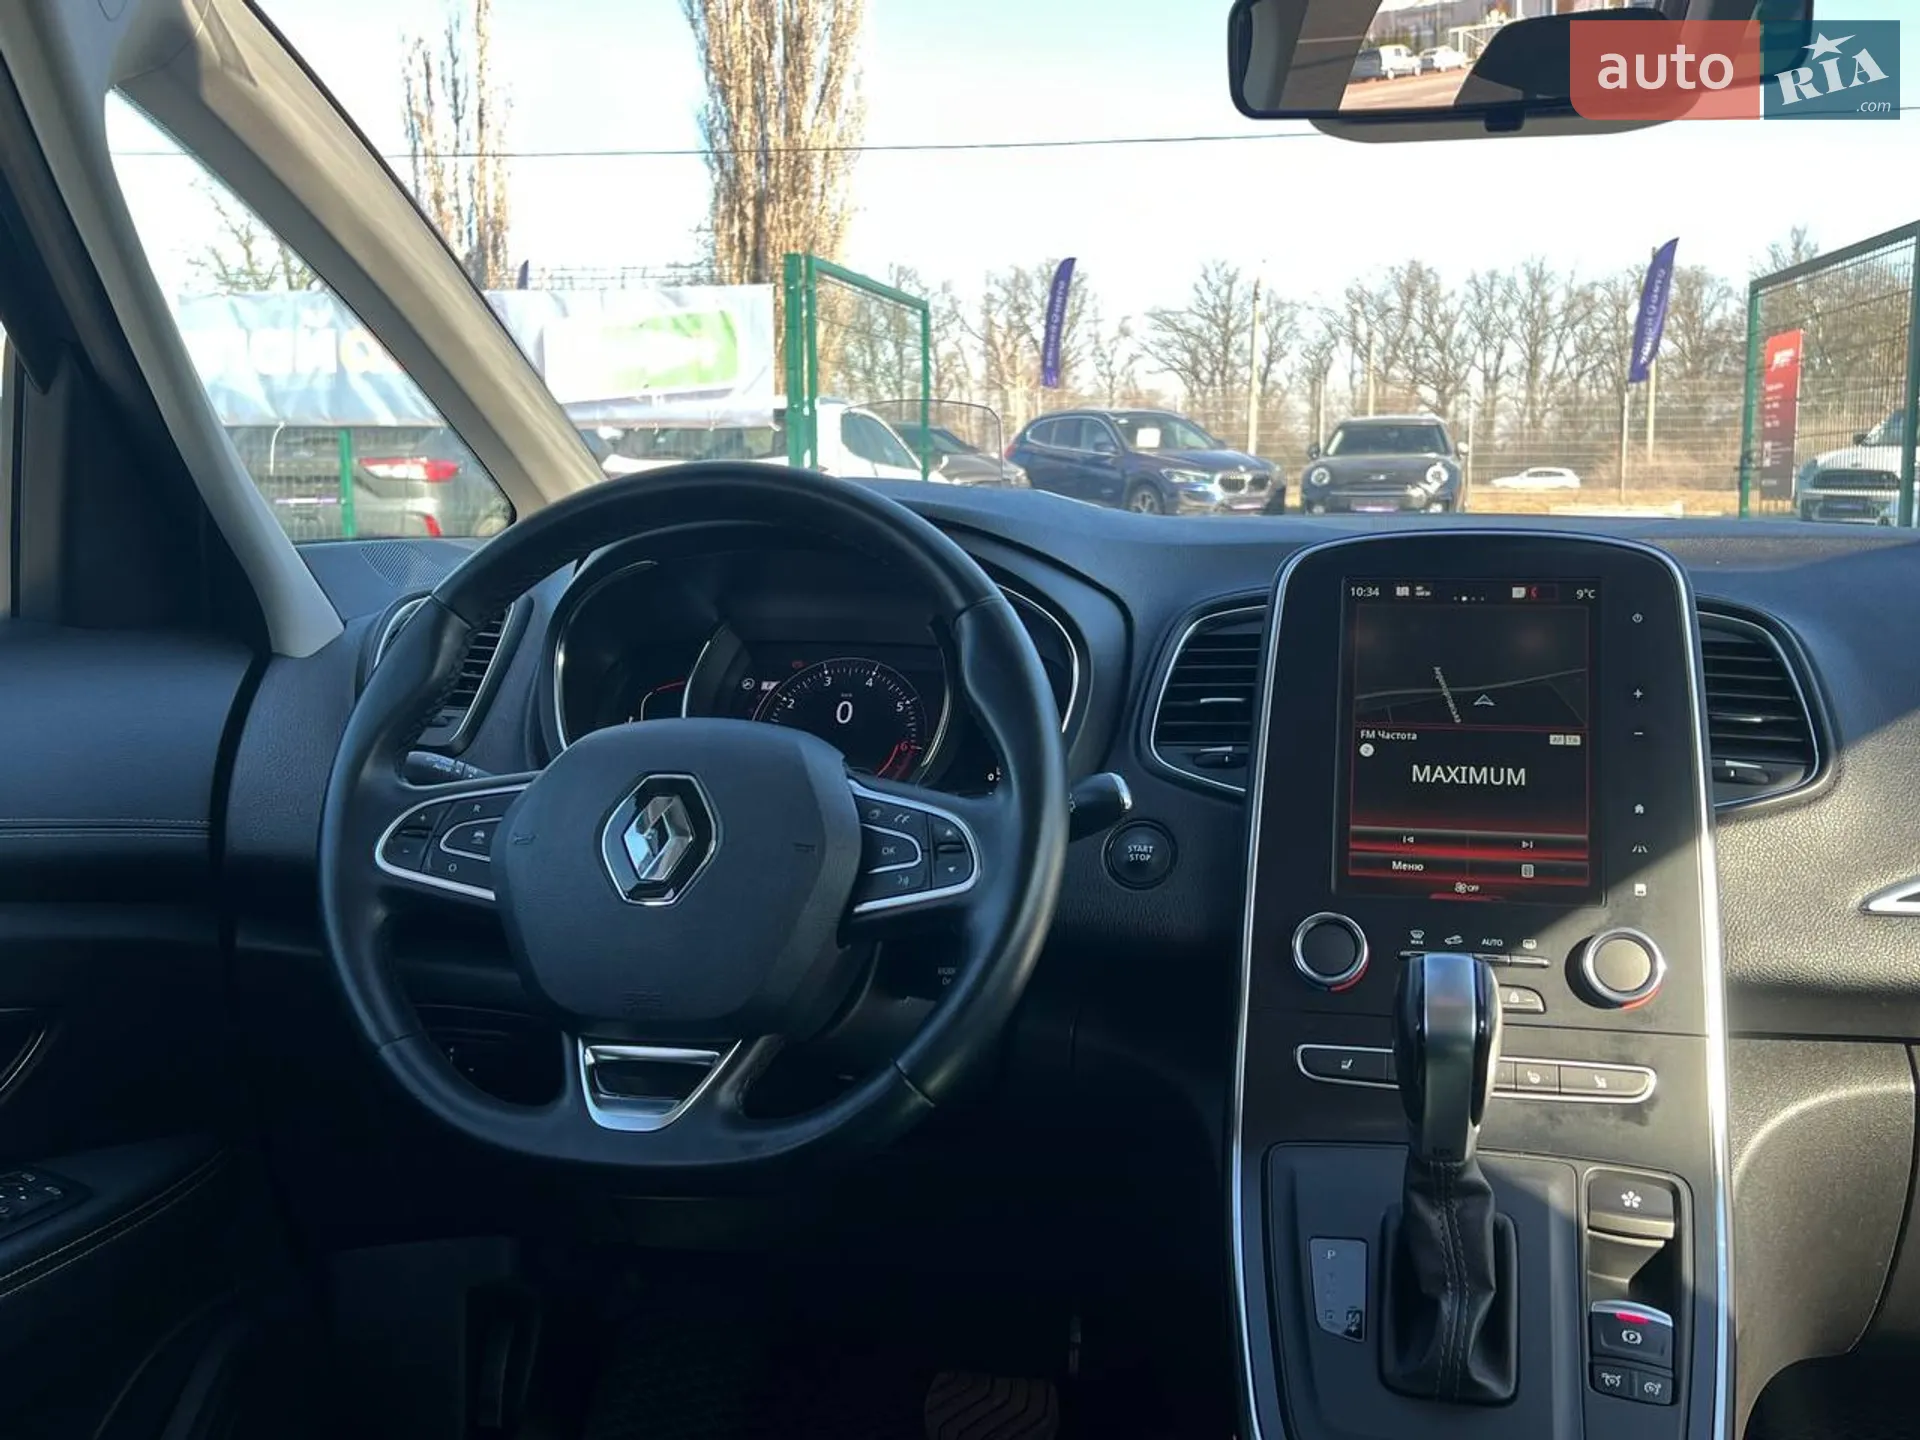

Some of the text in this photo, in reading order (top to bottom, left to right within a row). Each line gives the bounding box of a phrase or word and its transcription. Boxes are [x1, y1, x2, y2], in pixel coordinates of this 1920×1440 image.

[1350, 586, 1380, 598] 10:34
[1576, 588, 1596, 599] 9°C
[823, 676, 832, 687] 3
[865, 677, 874, 687] 4
[787, 699, 796, 710] 2
[896, 701, 904, 712] 5
[836, 701, 853, 724] 0
[1360, 729, 1417, 741] FM Частота
[900, 740, 909, 751] 6
[1411, 763, 1526, 786] MAXIMUM
[473, 804, 481, 813] R
[881, 846, 896, 854] OK
[1127, 845, 1154, 854] START
[1129, 853, 1151, 862] STOP
[1391, 860, 1424, 872] Меню
[1481, 937, 1504, 947] AUTO
[1327, 1249, 1336, 1260] P
